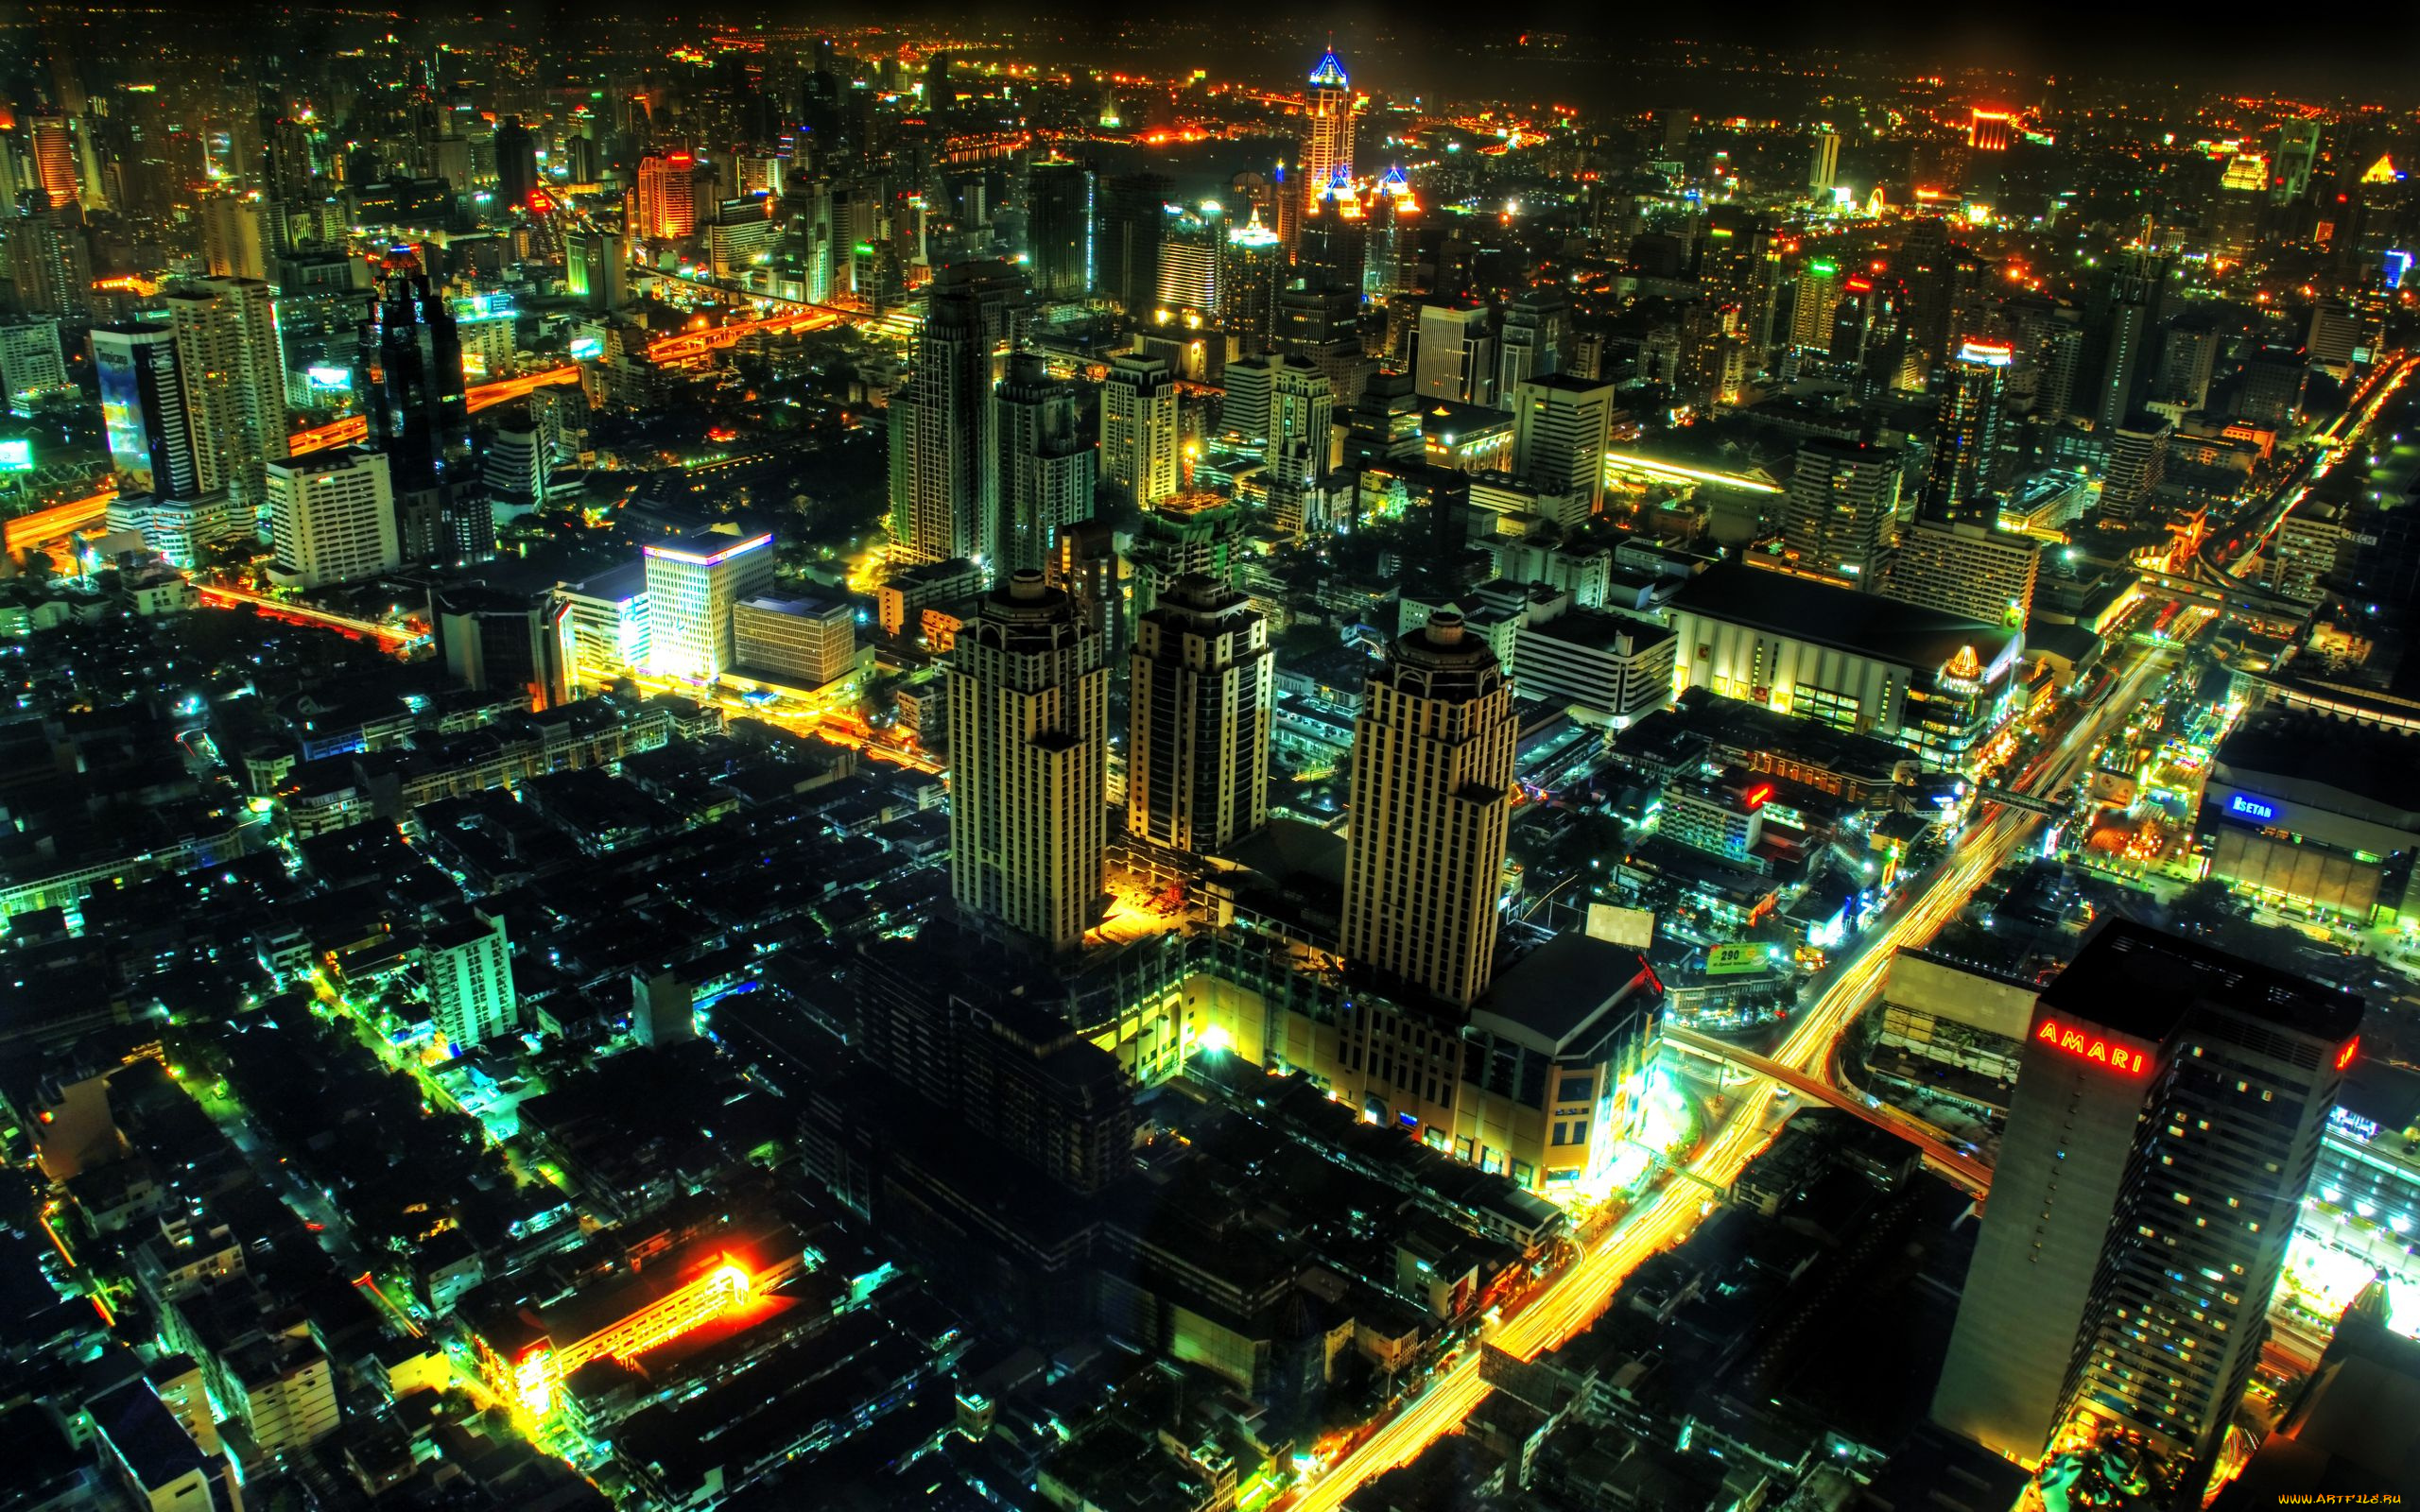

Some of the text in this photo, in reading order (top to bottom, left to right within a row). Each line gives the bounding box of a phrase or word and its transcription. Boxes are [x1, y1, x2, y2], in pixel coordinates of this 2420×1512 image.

[2232, 796, 2273, 818] ISETAN
[1720, 950, 1740, 961] 290
[2039, 1022, 2142, 1074] AMARI
